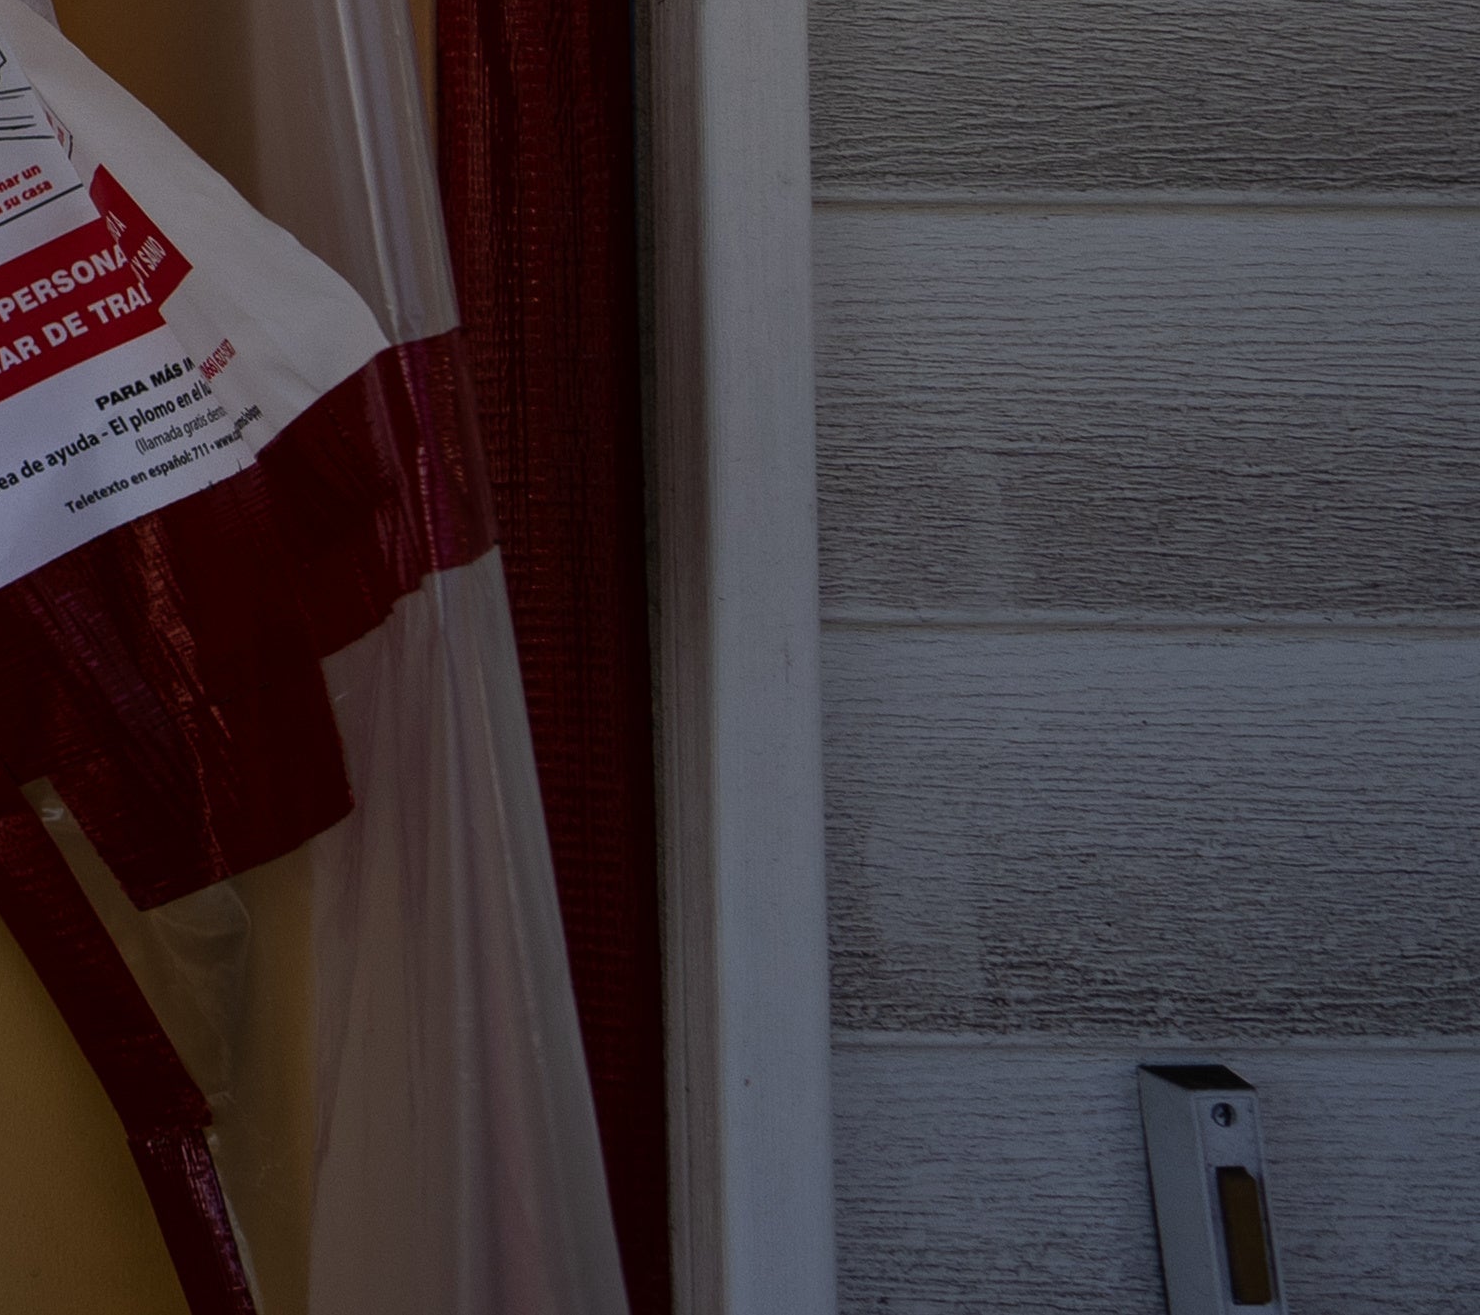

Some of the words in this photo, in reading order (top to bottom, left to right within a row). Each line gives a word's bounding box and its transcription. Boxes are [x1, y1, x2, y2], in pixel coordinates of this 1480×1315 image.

[20, 164, 41, 180] un
[2, 194, 21, 210] su
[21, 179, 53, 201] casa
[40, 309, 89, 348] DE
[19, 459, 44, 478] de
[44, 432, 100, 466] ayuda
[107, 415, 129, 436] El
[128, 399, 176, 432] plomo
[175, 392, 193, 408] en
[190, 381, 203, 401] el
[63, 478, 129, 513] Teletexto
[129, 470, 148, 485] en
[147, 449, 194, 478] español:
[190, 441, 210, 460] 711
